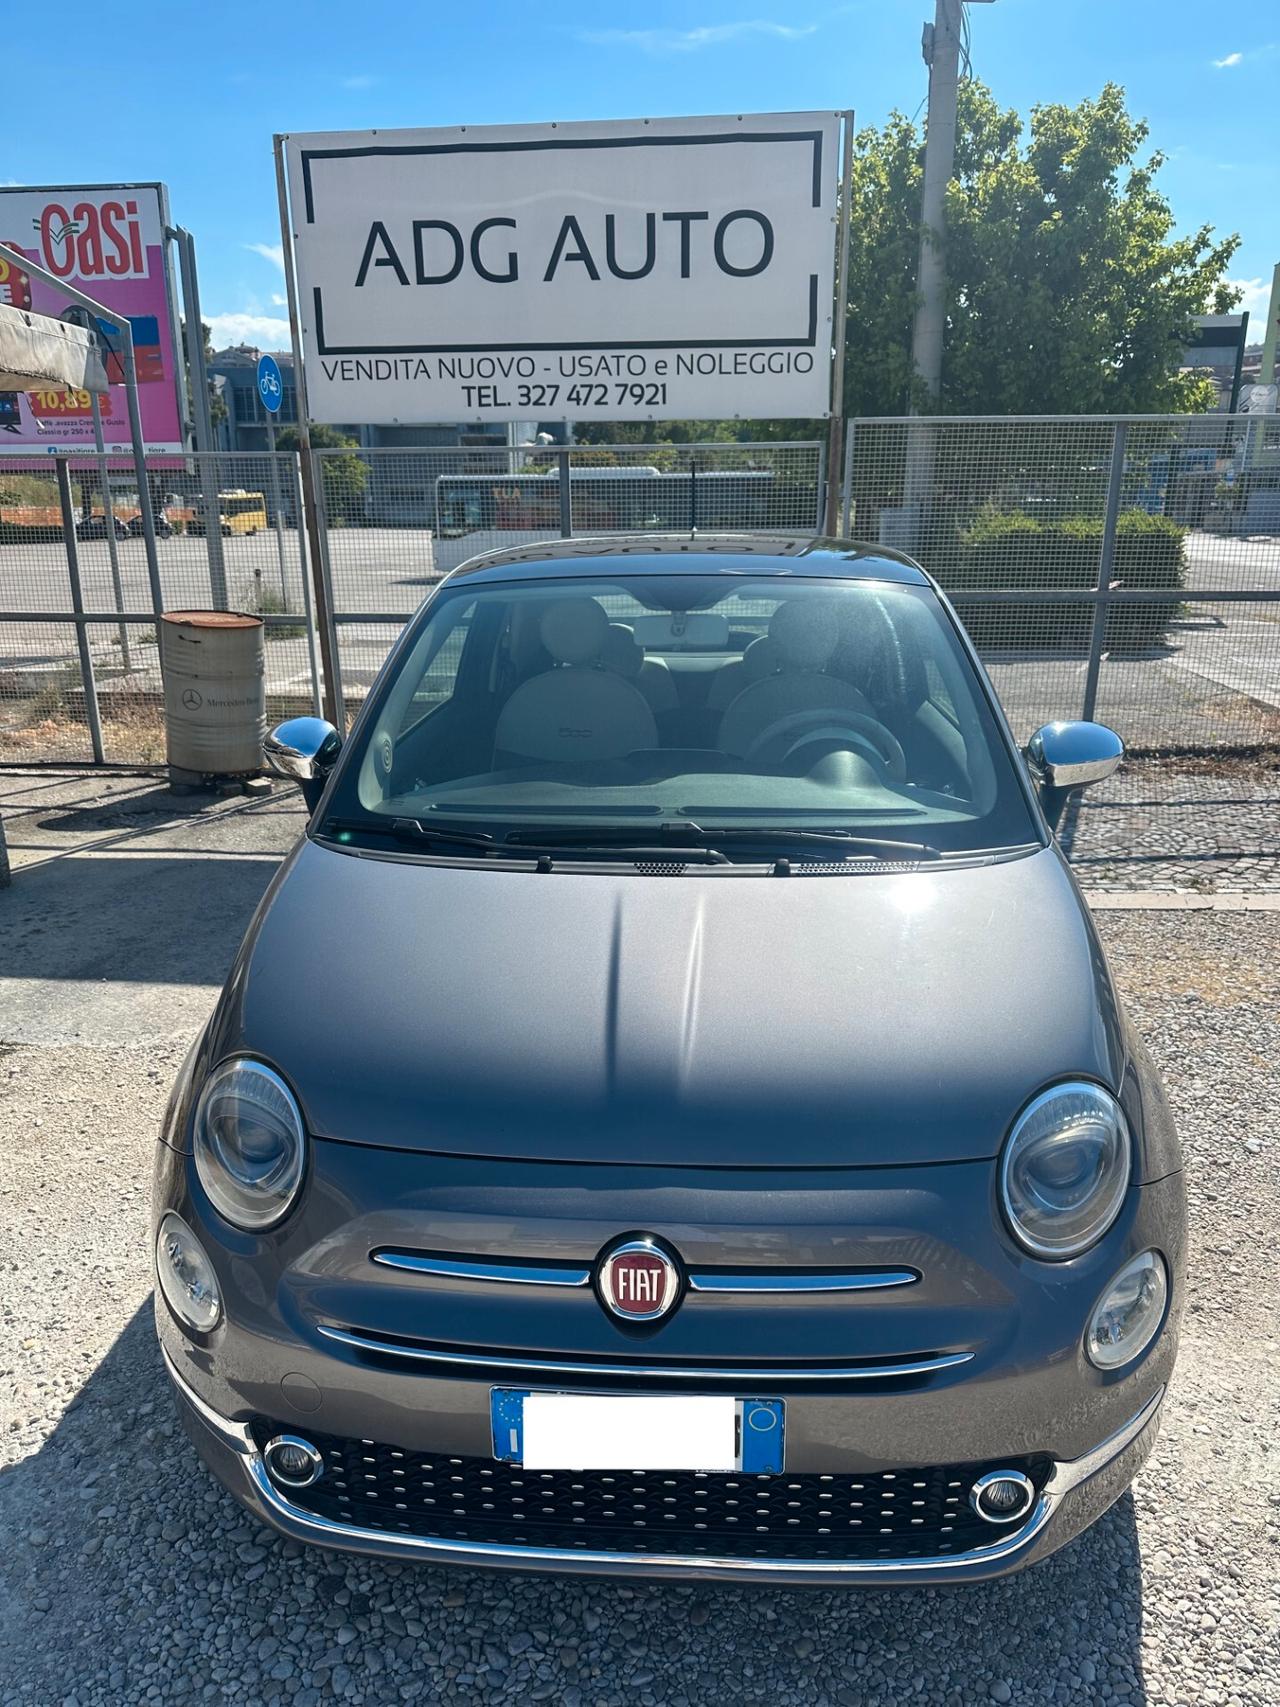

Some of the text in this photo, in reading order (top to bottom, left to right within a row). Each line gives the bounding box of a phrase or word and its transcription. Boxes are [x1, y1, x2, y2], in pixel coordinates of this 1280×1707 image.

[355, 210, 775, 287] ADG AUTO
[321, 358, 432, 381] VENDITA
[438, 356, 536, 379] NUOVO
[559, 354, 646, 377] USATO
[654, 359, 668, 376] e
[676, 351, 814, 376] NOLEGGIO
[461, 382, 666, 408] TEL. 327 472 7921
[618, 1268, 661, 1301] FIAT
